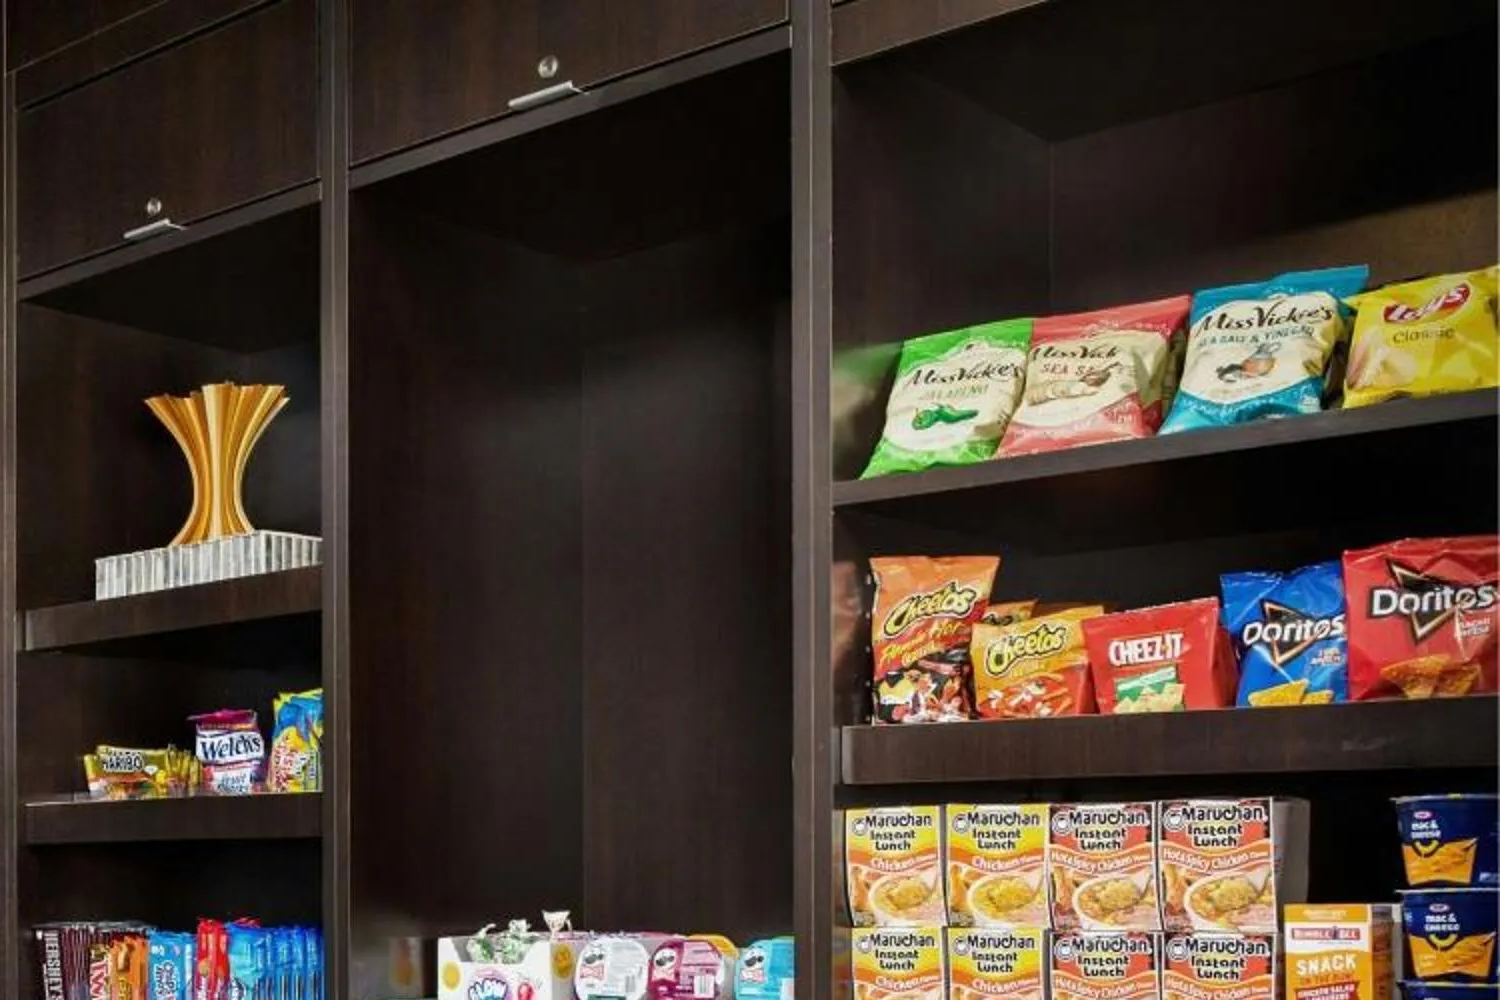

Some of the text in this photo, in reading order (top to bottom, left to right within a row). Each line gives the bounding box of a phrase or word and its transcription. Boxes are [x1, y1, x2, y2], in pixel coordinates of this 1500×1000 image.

[1196, 299, 1333, 337] Miss Vickie's
[1372, 584, 1494, 617] Doritos
[884, 581, 977, 636] Cheetos
[1242, 613, 1346, 645] Doritos
[985, 623, 1067, 676] Cheetos
[200, 735, 261, 761] Welch's
[967, 811, 1041, 827] Maruchan
[1069, 809, 1147, 826] Maruchan
[1181, 805, 1264, 822] Maruchan
[865, 813, 933, 829] Maruchan
[870, 830, 916, 840] Instant
[972, 829, 1022, 840] Instant
[1074, 827, 1127, 839] Instant
[1187, 823, 1244, 836] Instant
[875, 841, 911, 851] Lunch
[977, 839, 1016, 850] Lunch
[1080, 839, 1122, 850] Lunch
[1193, 835, 1238, 848] Lunch
[870, 933, 936, 948] Maruchan
[967, 934, 1035, 950] Maruchan
[1072, 937, 1148, 954] Maruchan
[1184, 937, 1268, 955] Maruchan
[875, 949, 919, 960] Instant
[971, 951, 1018, 962] Instant
[1078, 954, 1129, 967] Instant
[879, 960, 916, 971] Lunch
[977, 962, 1013, 973] Lunch
[1190, 955, 1246, 969] Instant
[1296, 954, 1358, 976] SNACK
[1083, 966, 1125, 978] Lunch
[1196, 967, 1240, 980] Lunch
